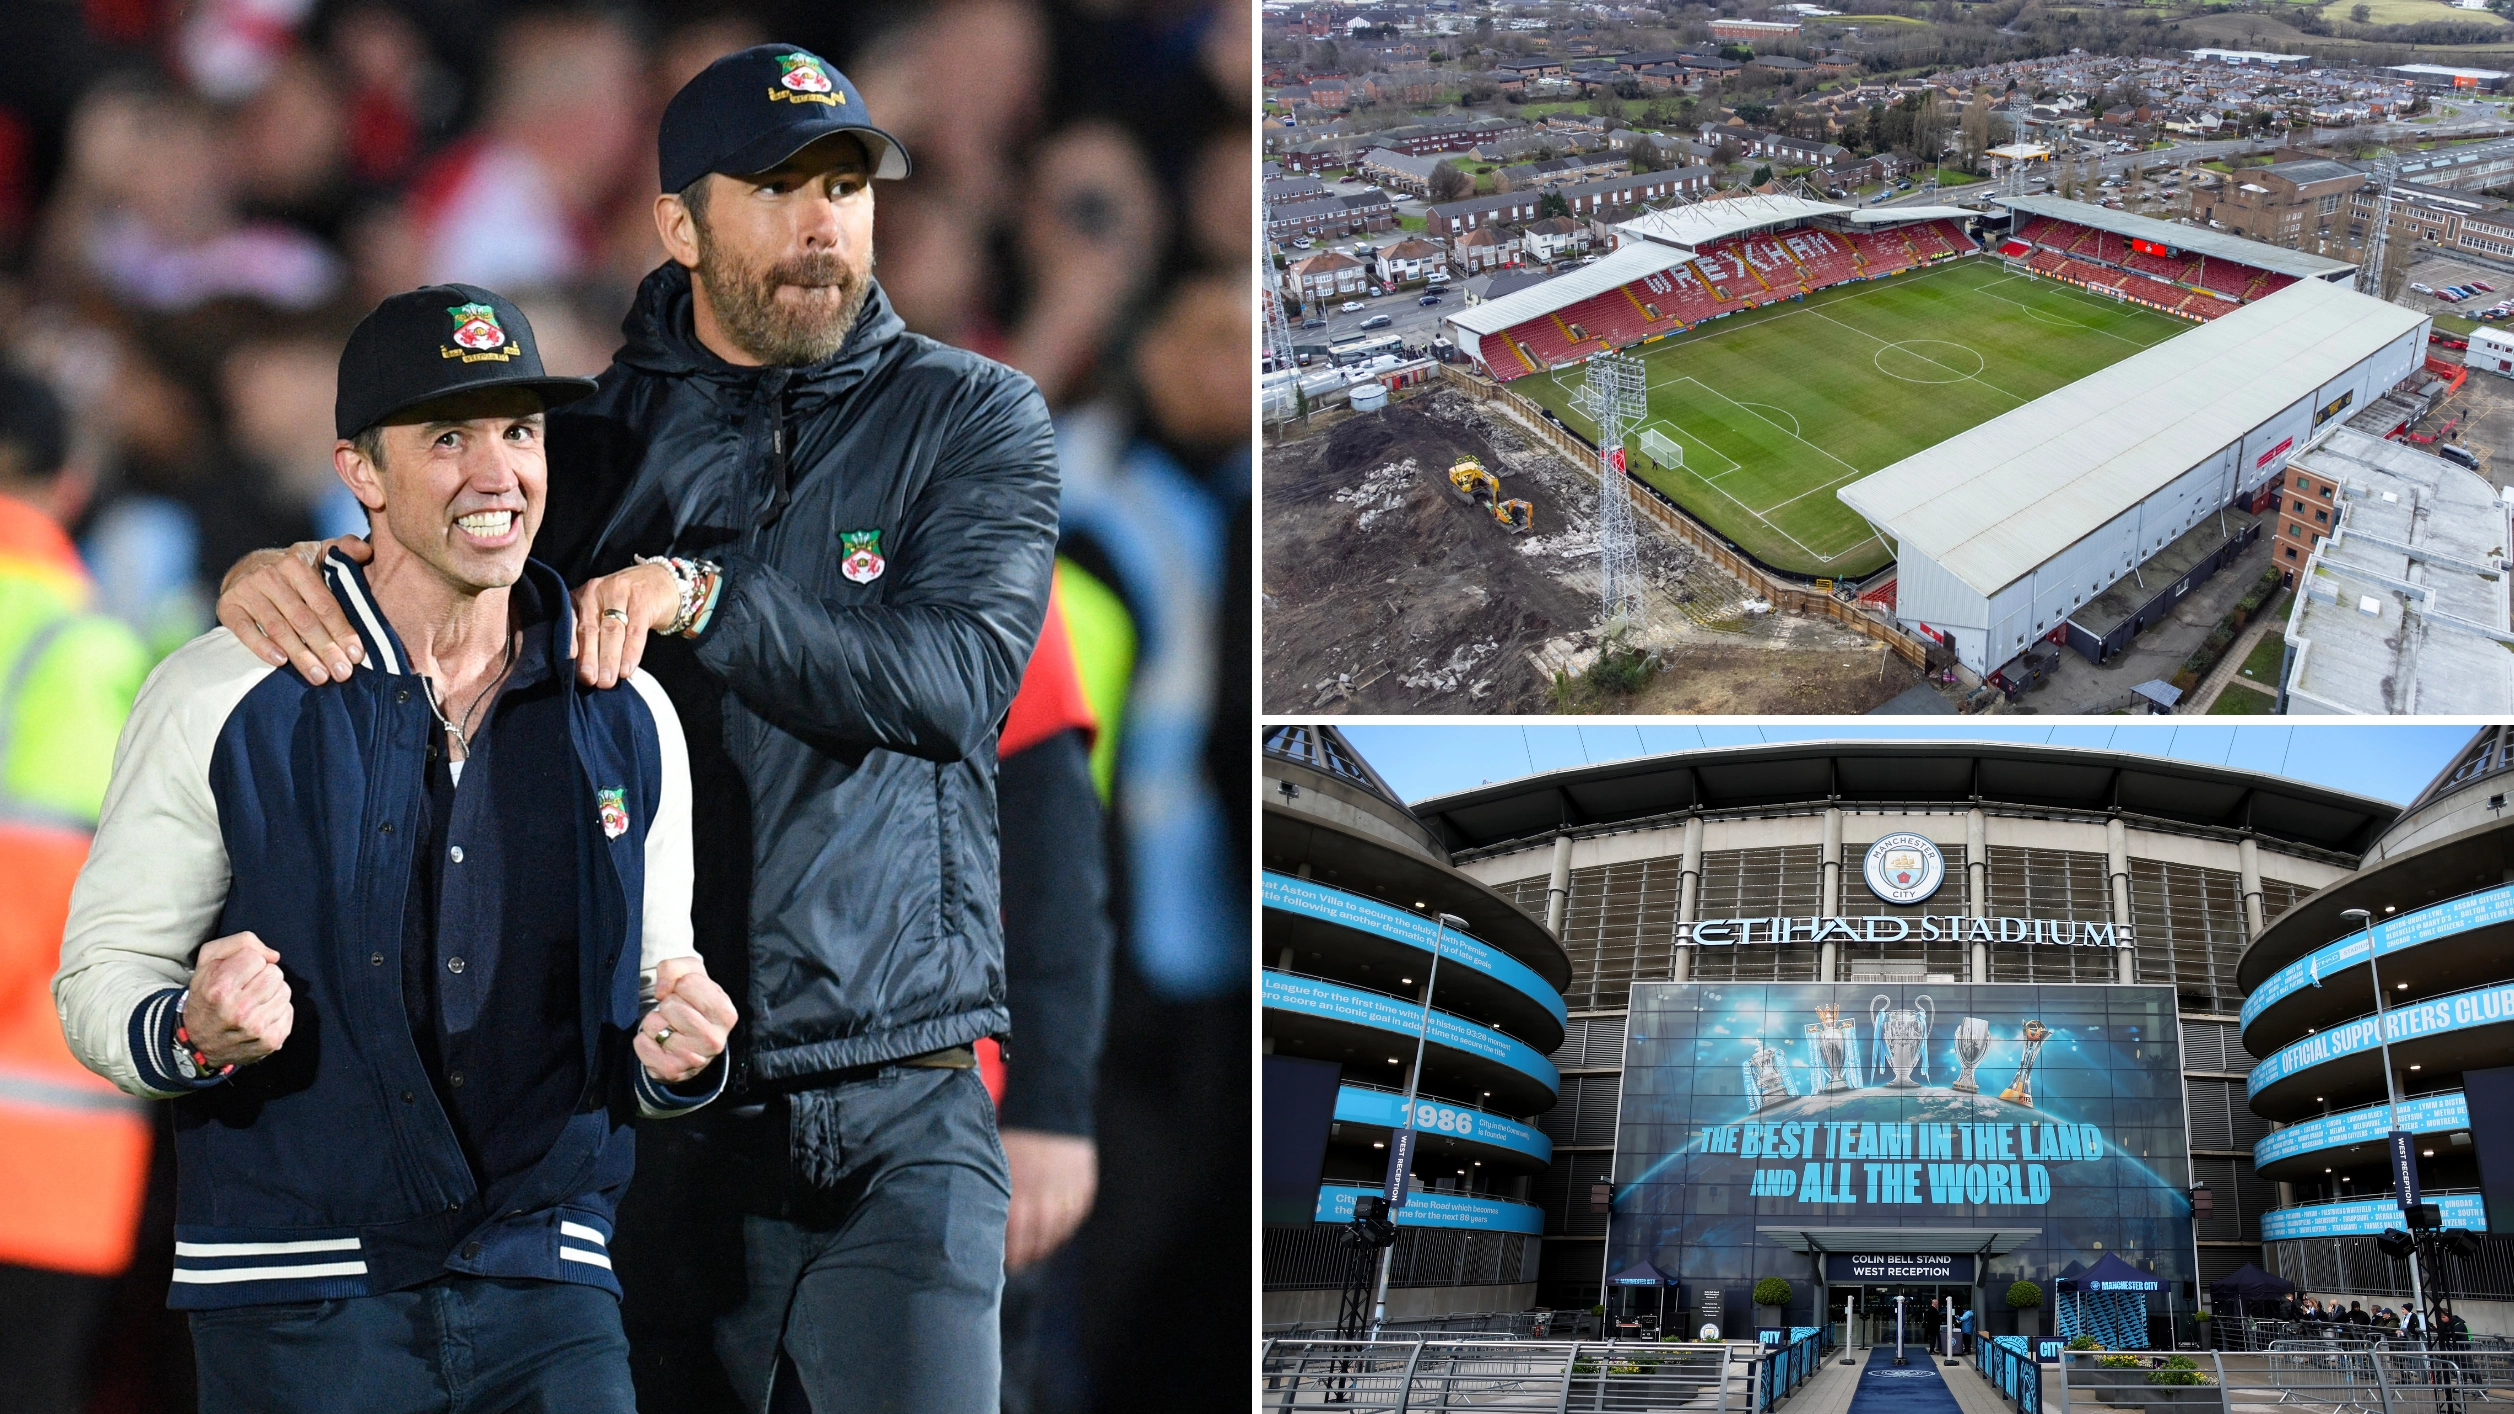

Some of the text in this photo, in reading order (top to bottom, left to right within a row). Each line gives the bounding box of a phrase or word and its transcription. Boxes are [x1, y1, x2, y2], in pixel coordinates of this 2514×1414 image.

[1644, 232, 1837, 294] WREXHAM
[1873, 837, 1935, 859] MANCHESTER
[1280, 884, 1316, 899] Aston
[1320, 893, 1343, 906] Villa
[1346, 901, 1356, 910] to
[1358, 907, 1393, 922] secure
[1395, 916, 1410, 928] the
[1412, 923, 1437, 937] club's
[1460, 940, 1487, 957] Premier
[2385, 890, 2511, 932] ASHTON-UNDER-LYNE ASSAM CITYZENS
[1283, 896, 1337, 917] following
[1340, 911, 1381, 928] another
[1382, 923, 1425, 942] dramatic
[1427, 937, 1448, 953] flury
[1450, 947, 1459, 955] of
[1460, 950, 1473, 961] late
[1474, 957, 1492, 969] goals
[1692, 914, 2117, 948] ETIHAD STADIUM
[2386, 927, 2415, 940] BLUEBELLS
[2423, 919, 2440, 928] MARY
[2442, 914, 2452, 923] D'S
[2460, 906, 2485, 918] BOLTON
[2387, 936, 2410, 948] CHICAGO
[2420, 927, 2436, 938] CHILE
[2437, 920, 2464, 932] CITIZENS
[2475, 911, 2507, 923] CHILTERN
[2315, 954, 2339, 968] TIHAD
[1266, 979, 1310, 995] League
[1313, 988, 1329, 998] for
[1331, 993, 1349, 1003] the
[1351, 997, 1373, 1008] first
[1375, 1002, 1397, 1014] time
[1399, 1008, 1419, 1020] with
[1436, 1018, 1464, 1034] historic
[1466, 1029, 1486, 1041] 93:20
[1488, 1037, 1511, 1051] moment
[1283, 995, 1316, 1007] score
[1319, 1002, 1333, 1010] an
[1335, 1004, 1367, 1017] iconic
[1369, 1012, 1390, 1023] goal
[1392, 1016, 1400, 1025] in
[1403, 1019, 1430, 1033] added
[1432, 1027, 1449, 1039] time
[1451, 1033, 1458, 1041] to
[1460, 1038, 1482, 1050] secure
[1484, 1043, 1493, 1053] the
[1494, 1047, 1505, 1057] title
[2282, 988, 2514, 1074] OFFICIAL SUPPORTERS CLUB
[1401, 1103, 1472, 1134] 1986
[2368, 1110, 2383, 1119] BLUES
[2419, 1101, 2438, 1111] LYMM
[2390, 1112, 2423, 1123] MRSEYSIDE
[2434, 1108, 2455, 1117] METRO
[1478, 1127, 1507, 1140] is founded
[1479, 1118, 1491, 1129] City
[1498, 1122, 1506, 1131] the
[1506, 1126, 1530, 1140] Community
[2426, 1119, 2459, 1127] MONTREAL
[1701, 1121, 2104, 1161] THE BEST TEAM IN THE LAND
[1391, 1135, 1408, 1201] WEST RECEPTION
[2398, 1138, 2413, 1204] WEST RECEPTION
[1750, 1162, 2051, 1204] AND ALL THE WORLD
[1335, 1206, 1352, 1214] the
[1427, 1212, 1440, 1220] the
[1442, 1213, 1458, 1221] next
[1459, 1213, 1469, 1221] 80
[1471, 1215, 1487, 1223] years
[1430, 1201, 1450, 1210] Road
[1450, 1203, 1471, 1212] which
[1473, 1205, 1498, 1214] becomes
[2445, 1199, 2473, 1208] QINGDAO
[2458, 1208, 2479, 1217] SOUTH
[2442, 1218, 2467, 1226] ITYZENS
[1852, 1255, 1951, 1264] COLIN BELL STAND
[1854, 1267, 1949, 1276] WEST RECEPTION
[2102, 1281, 2158, 1290] MANCHESTER CITY
[1760, 1331, 1780, 1344] CITY
[2040, 1341, 2064, 1357] CITY
